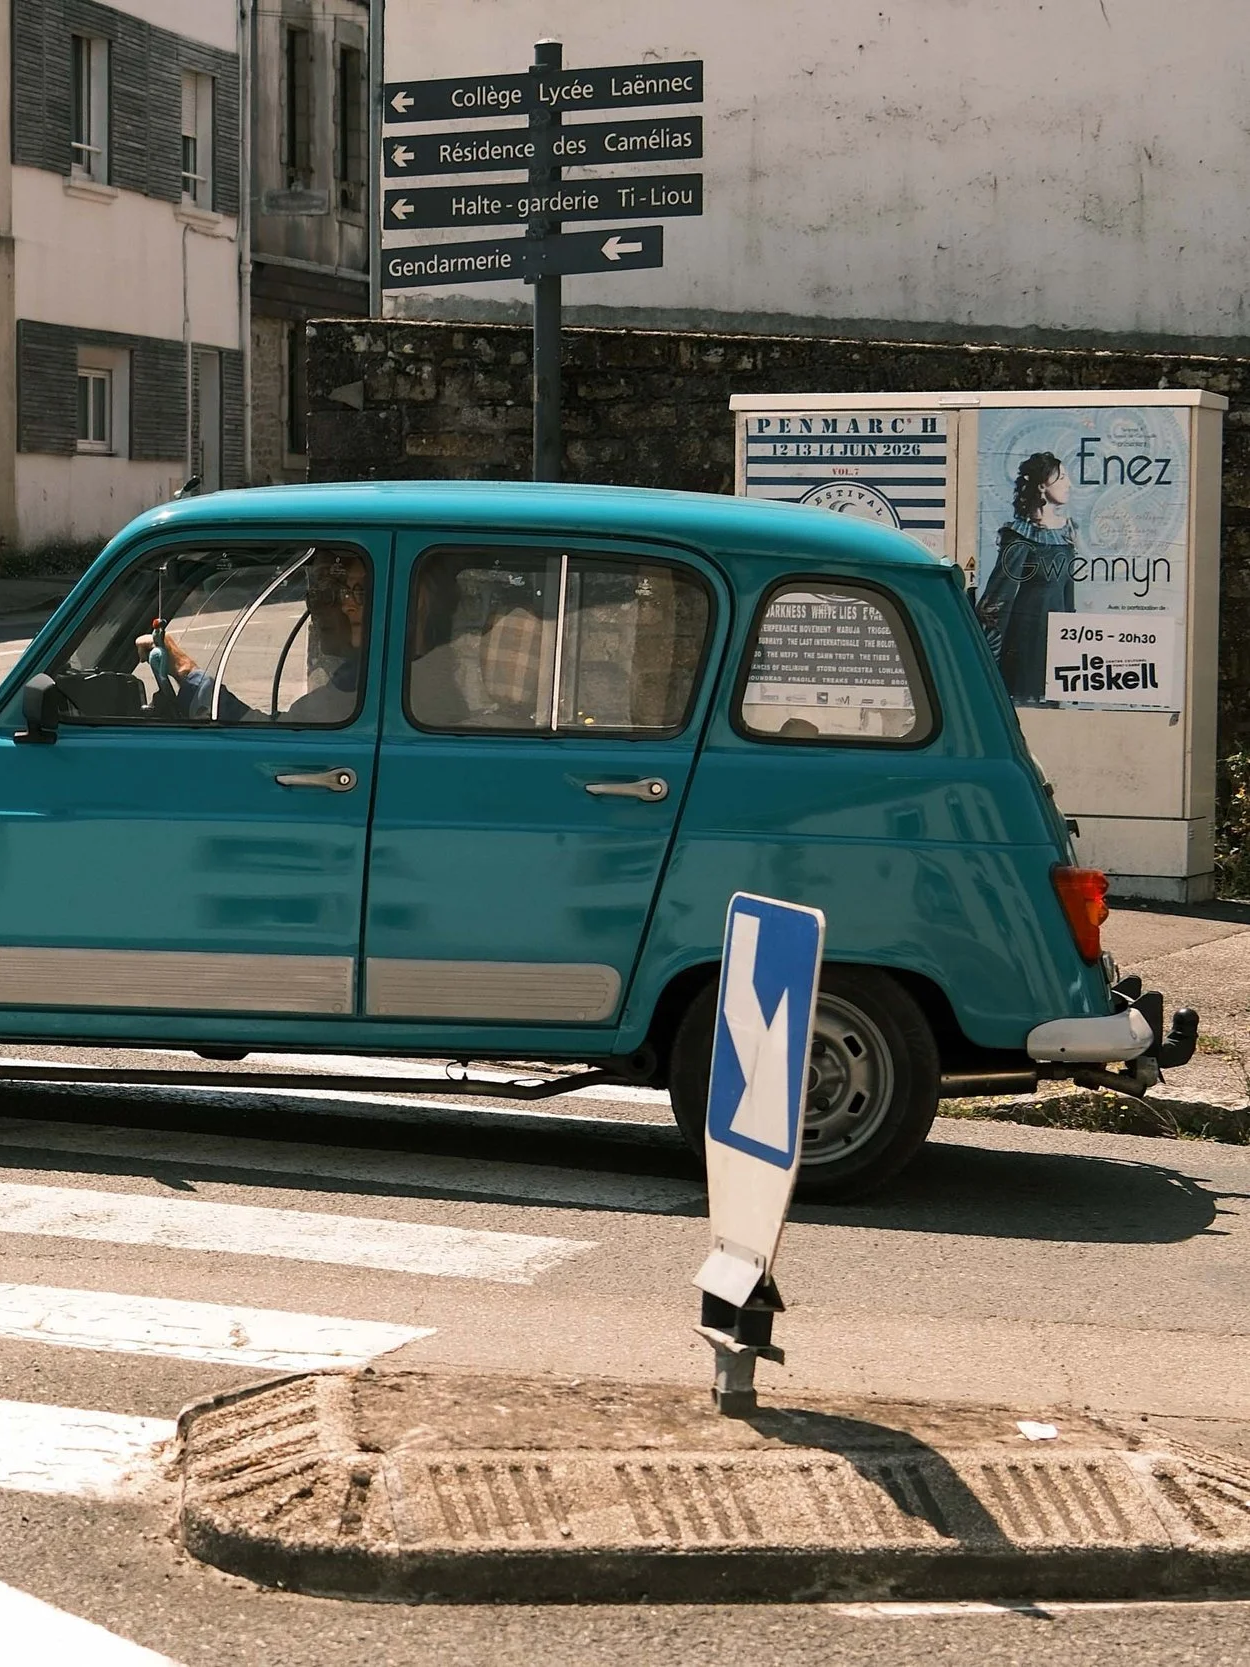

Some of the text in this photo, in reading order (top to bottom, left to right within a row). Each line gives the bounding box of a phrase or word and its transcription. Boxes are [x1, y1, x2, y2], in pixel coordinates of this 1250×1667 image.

[451, 74, 694, 110] Collège Lycée Laënnec
[440, 128, 692, 164] Résidence des Camélias
[388, 252, 512, 278] Gendarmerie
[840, 444, 878, 456] JUIN
[882, 444, 921, 456] 2026
[1076, 437, 1172, 486] Enez
[814, 490, 883, 516] ESTIVAL
[1002, 540, 1170, 598] Gwennyn
[811, 605, 836, 620] WHITE
[839, 606, 858, 620] LIES
[868, 626, 892, 634] TRIGGE
[1060, 626, 1104, 644] 23/05
[1118, 632, 1156, 644] 20h30
[1082, 653, 1104, 670] le
[1054, 662, 1158, 692] Triskell
